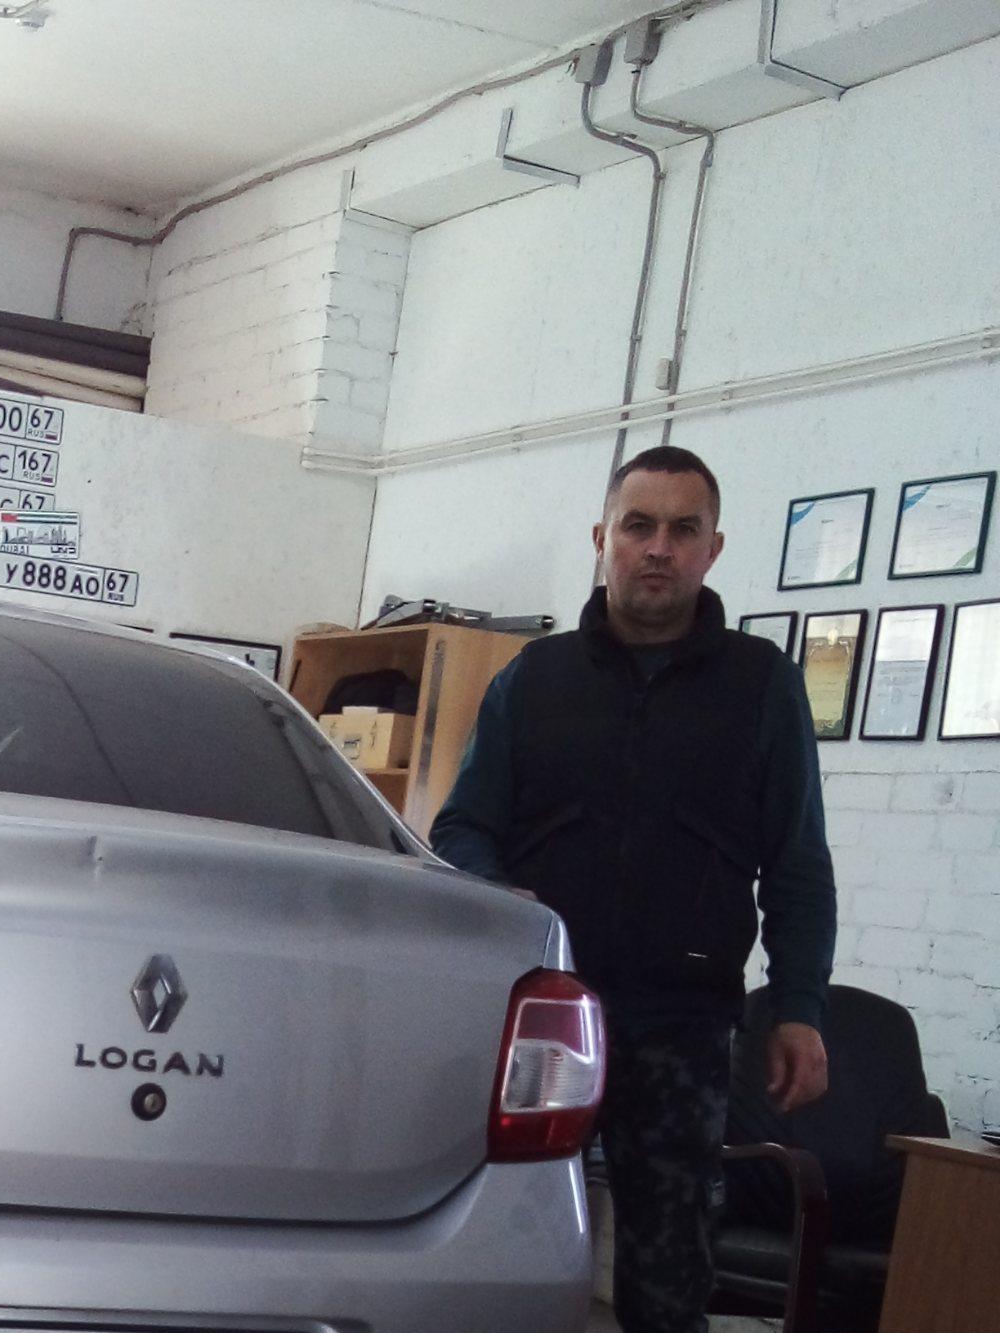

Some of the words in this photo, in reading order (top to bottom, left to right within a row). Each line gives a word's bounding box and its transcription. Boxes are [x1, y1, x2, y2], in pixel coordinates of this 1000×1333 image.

[30, 408, 54, 430] 67
[18, 451, 52, 478] 167
[6, 560, 99, 596] У888АО
[106, 571, 129, 593] 67
[74, 1043, 225, 1078] LOGAN
